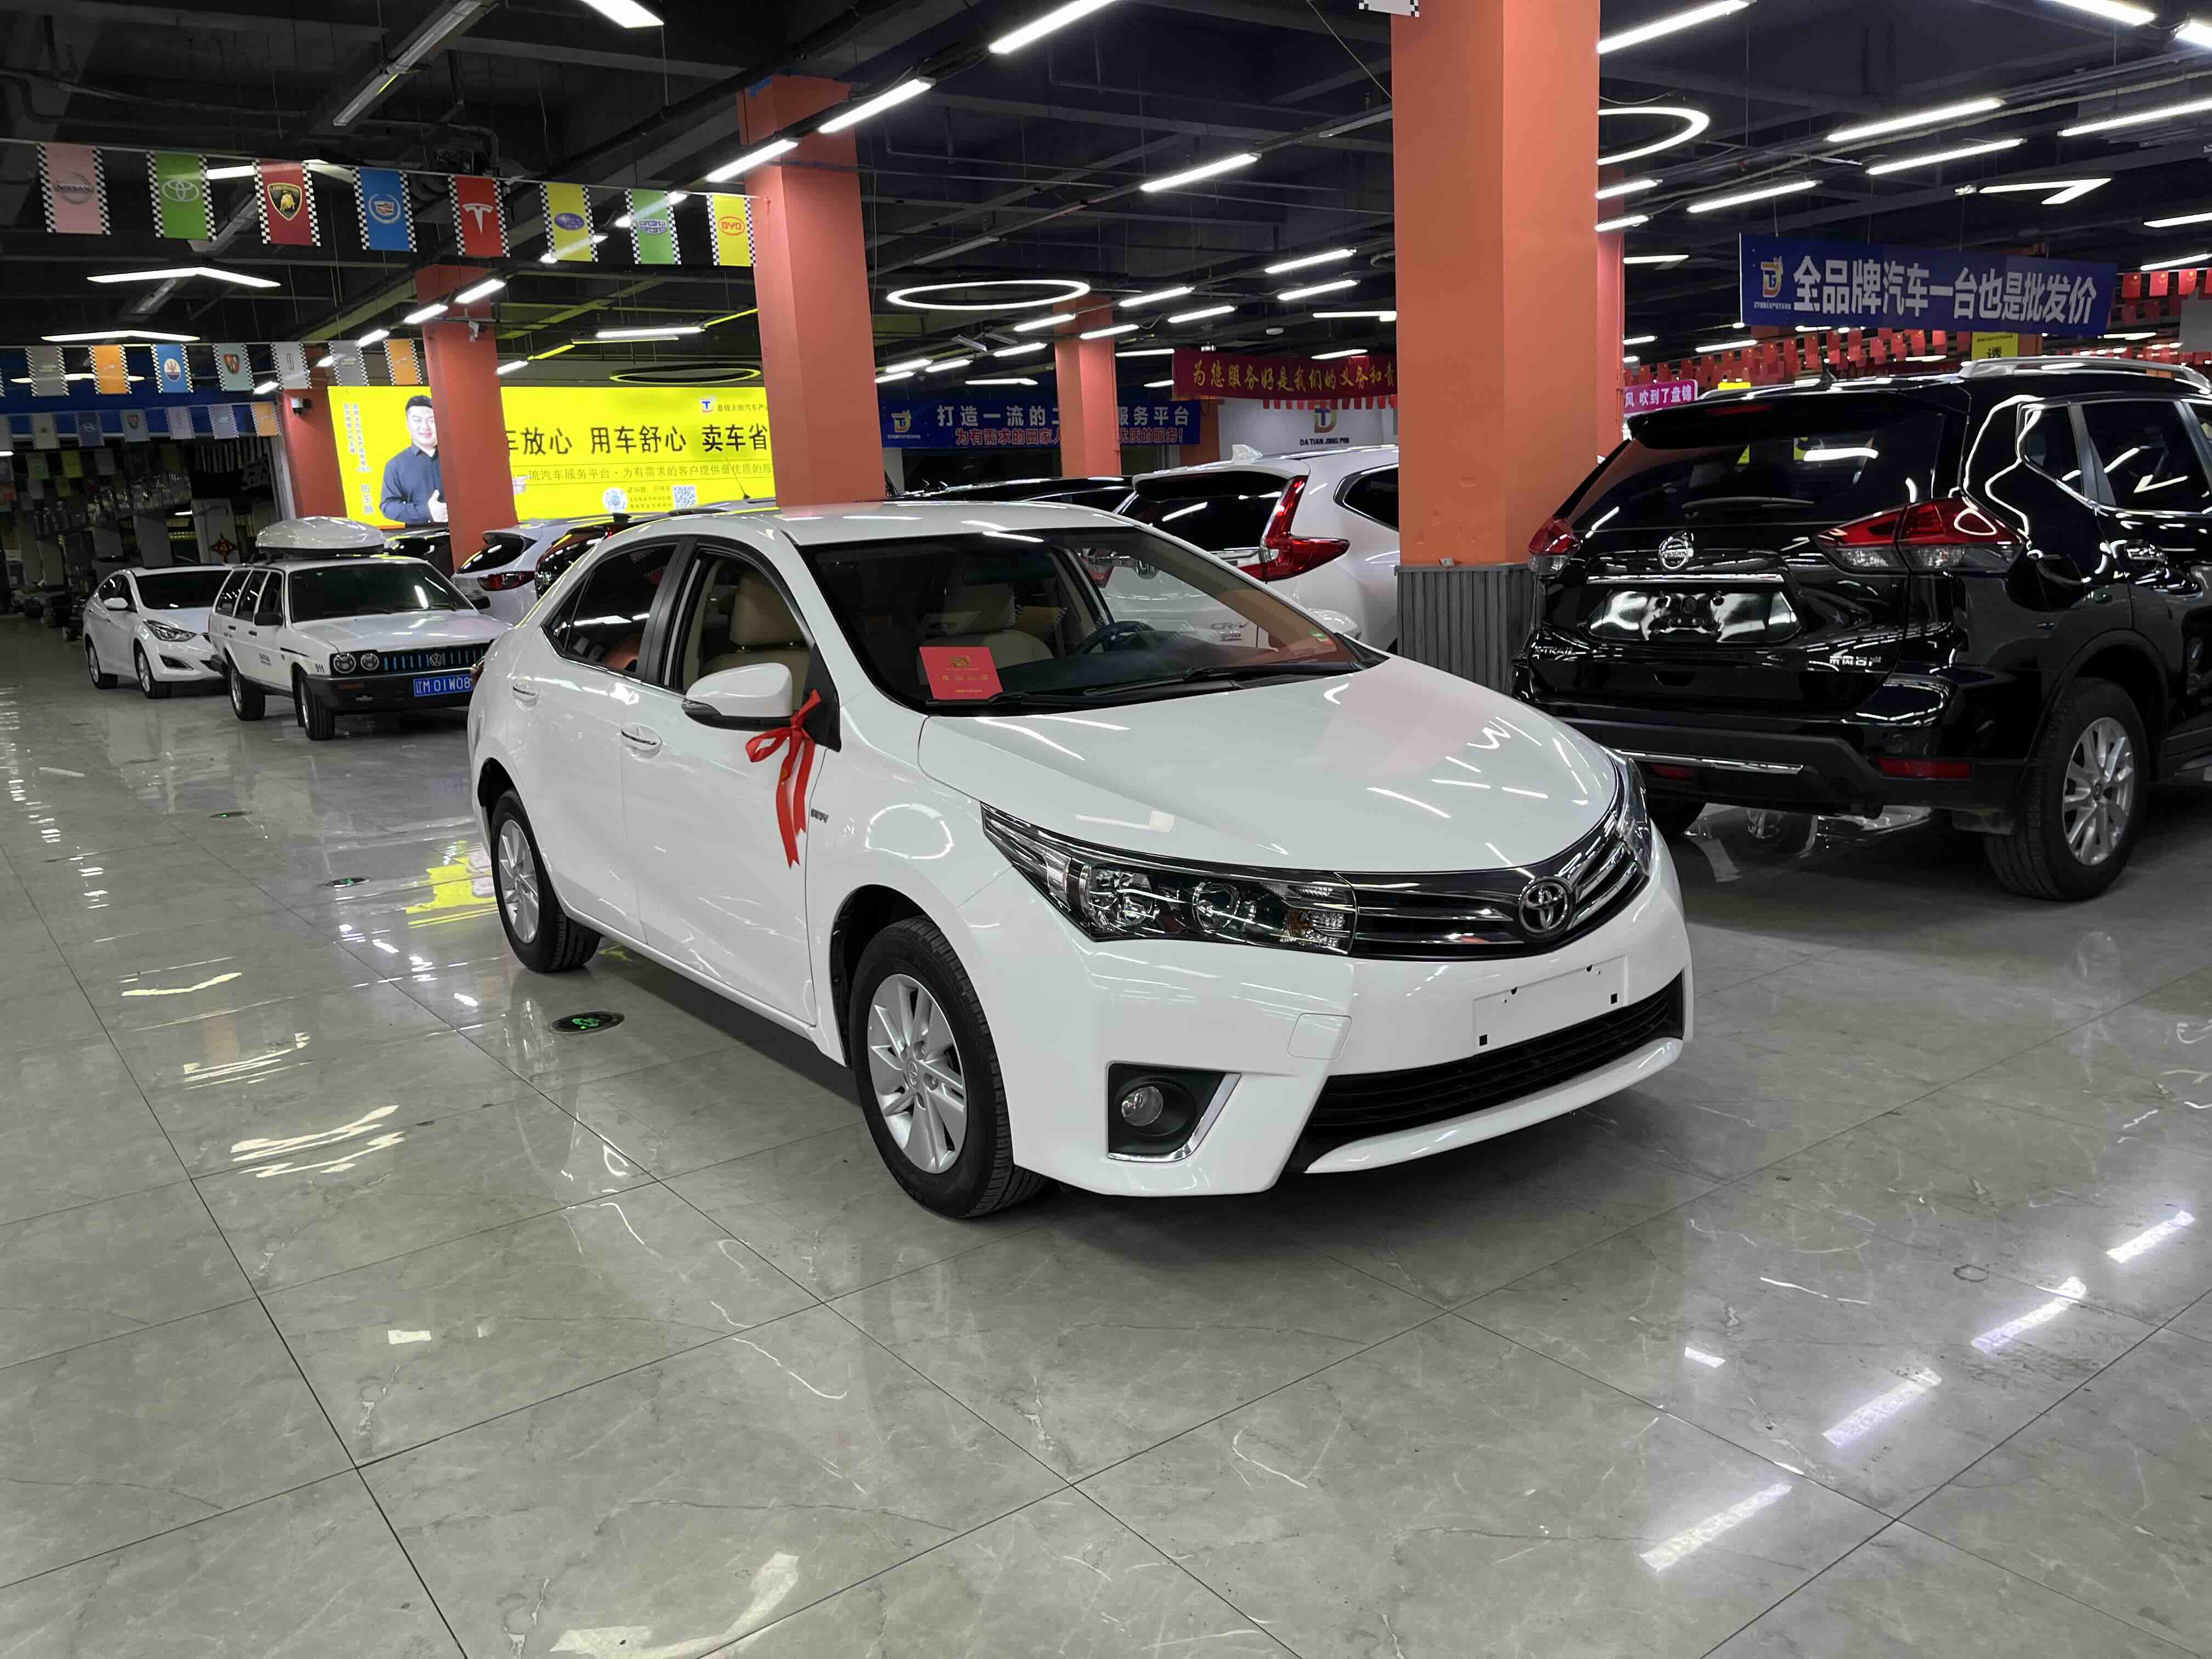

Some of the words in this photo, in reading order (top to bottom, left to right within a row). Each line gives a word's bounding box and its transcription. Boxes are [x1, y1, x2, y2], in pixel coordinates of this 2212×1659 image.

[1793, 255, 2097, 325] 全品牌汽车一台也是批发价
[1639, 384, 1692, 405] 吹到了盘锦
[591, 425, 687, 454] 用车舒心
[702, 424, 768, 453] 卖车省
